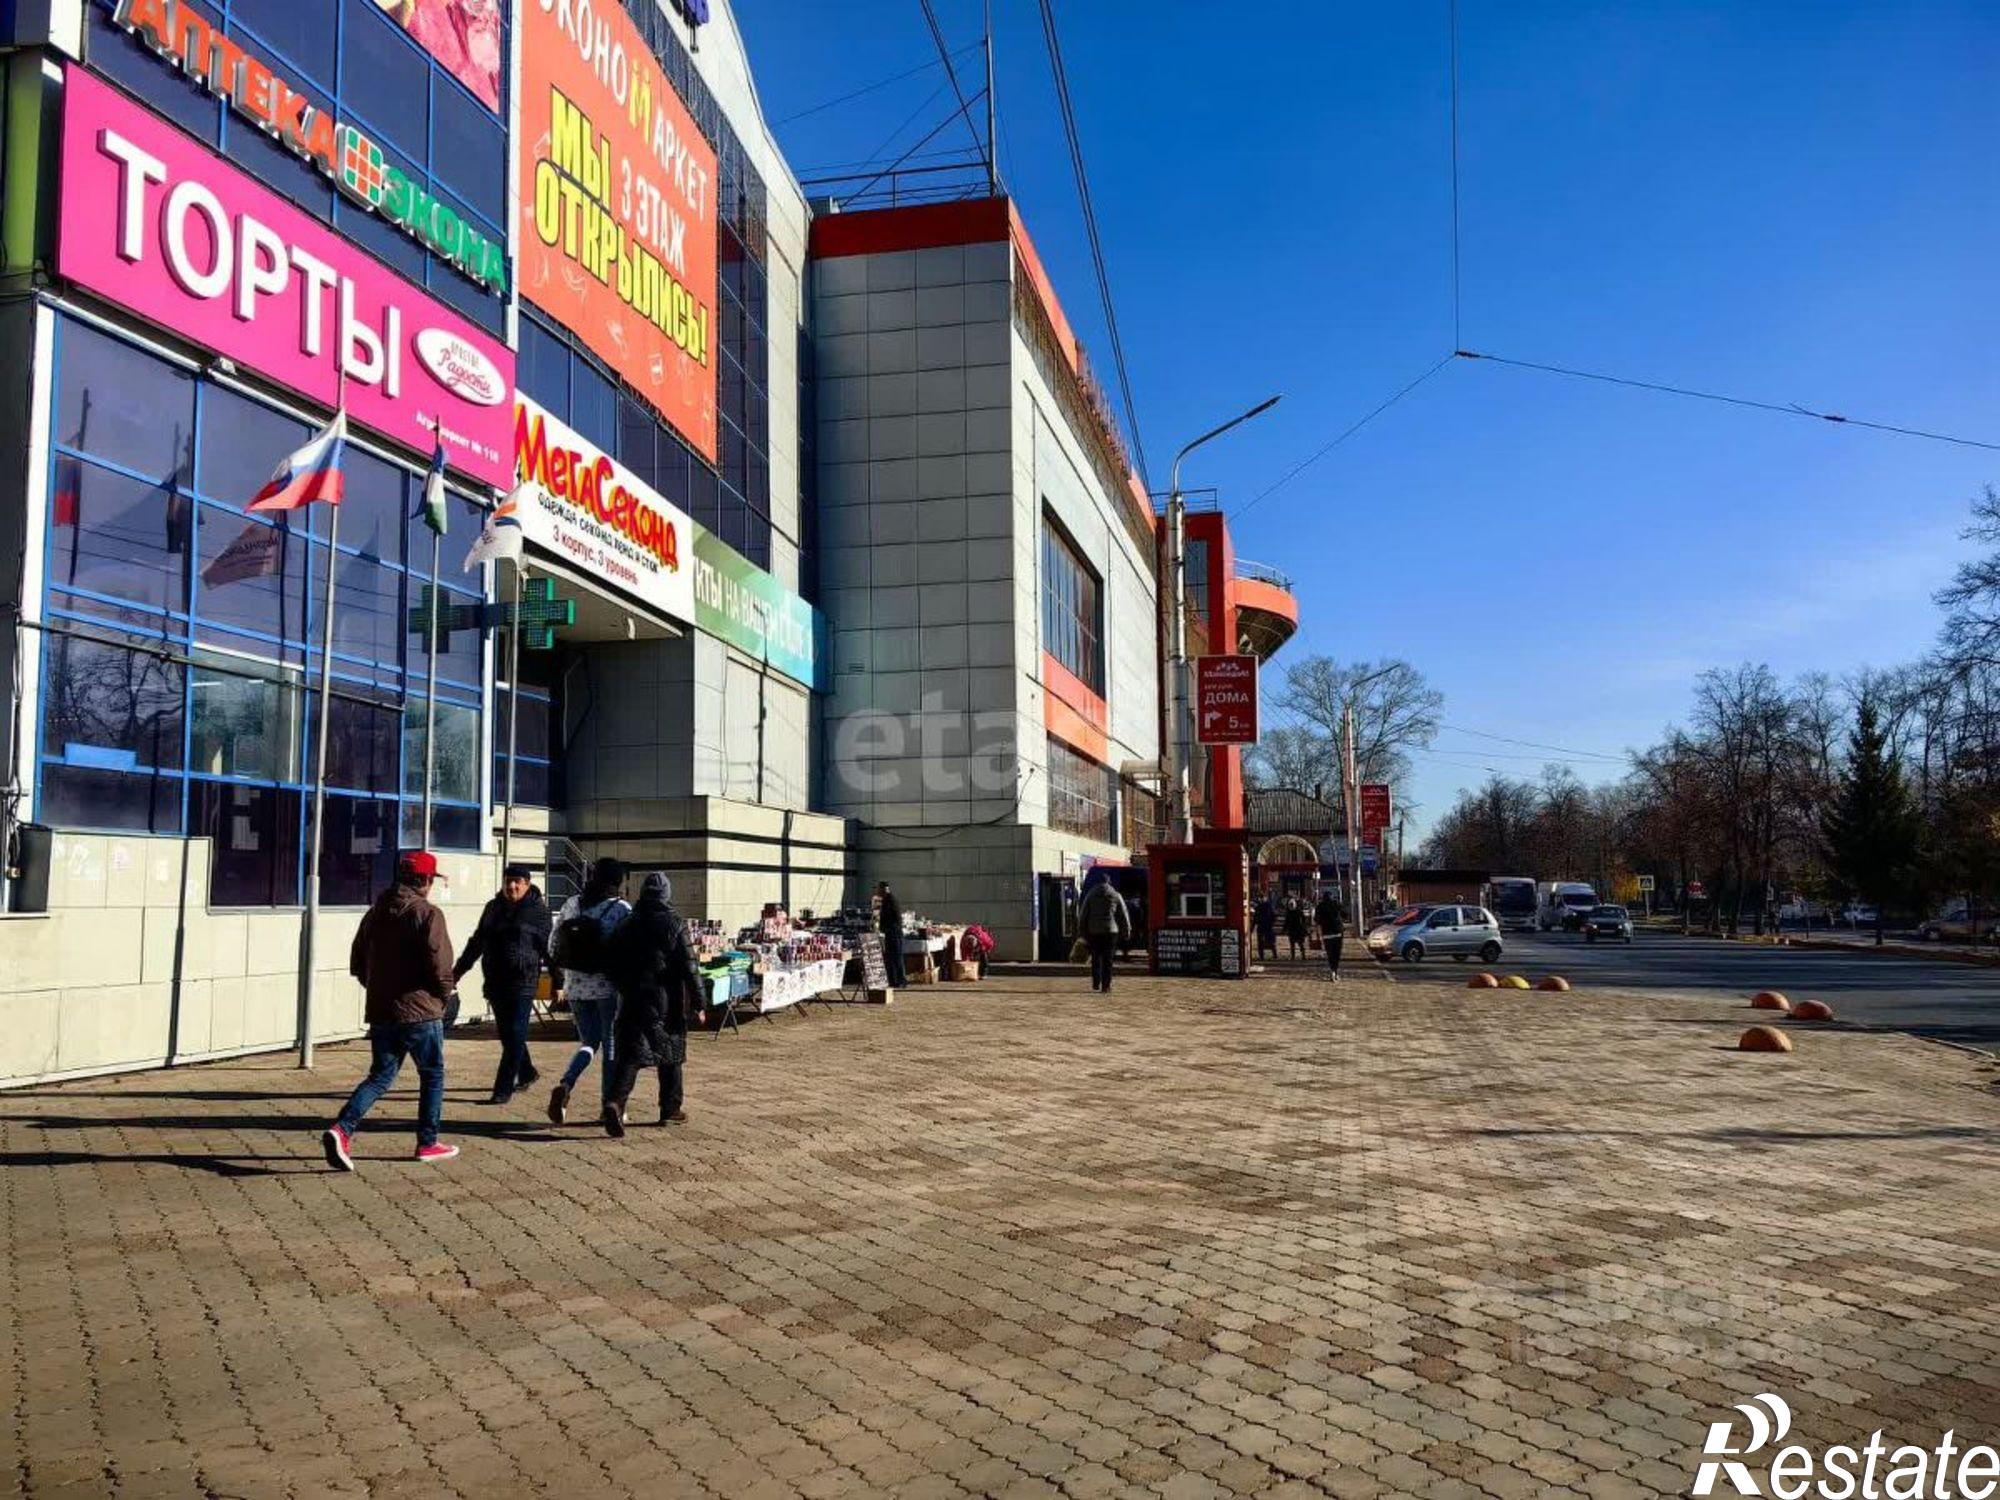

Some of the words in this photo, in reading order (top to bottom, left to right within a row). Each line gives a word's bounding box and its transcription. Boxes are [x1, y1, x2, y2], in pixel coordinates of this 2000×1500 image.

[113, 0, 339, 178] АПТЕКА
[550, 82, 611, 215] МЫ
[97, 127, 400, 399] ТОРТЫ
[381, 164, 506, 297] ЭКОМА
[535, 158, 708, 369] ОТКРЫЛИСЬ!
[621, 156, 633, 221] 3
[636, 174, 687, 278] ЭТАЖ
[1204, 692, 1250, 706] ДОМА
